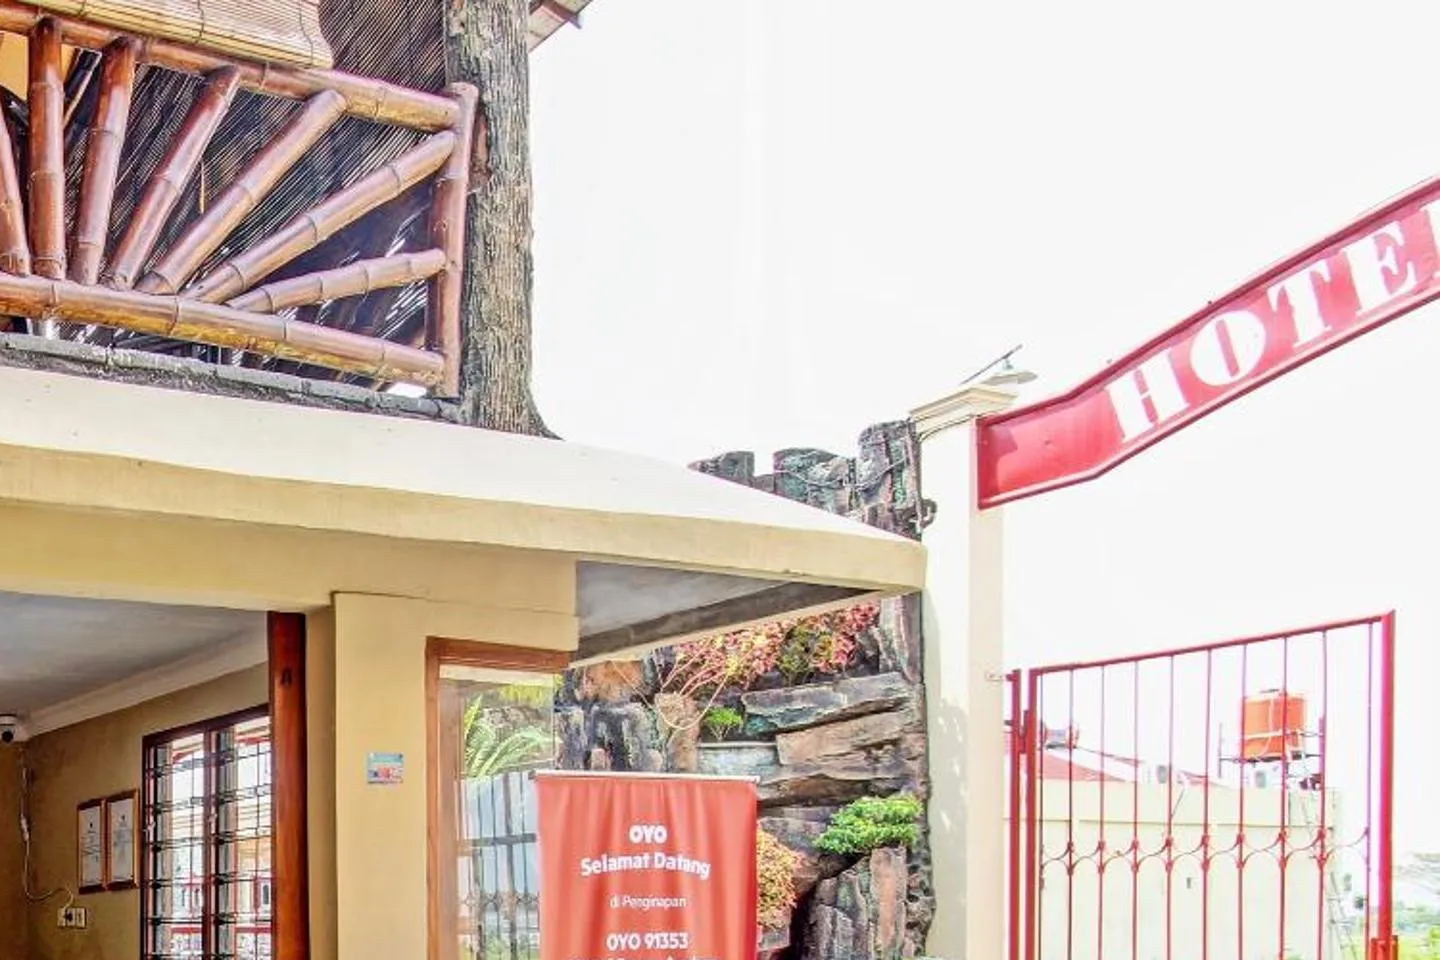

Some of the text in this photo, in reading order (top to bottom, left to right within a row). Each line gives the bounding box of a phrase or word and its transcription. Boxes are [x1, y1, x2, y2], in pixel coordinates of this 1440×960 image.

[629, 824, 667, 844] OYO
[580, 852, 711, 880] Selamat Datang
[606, 932, 689, 951] OYO 91353
